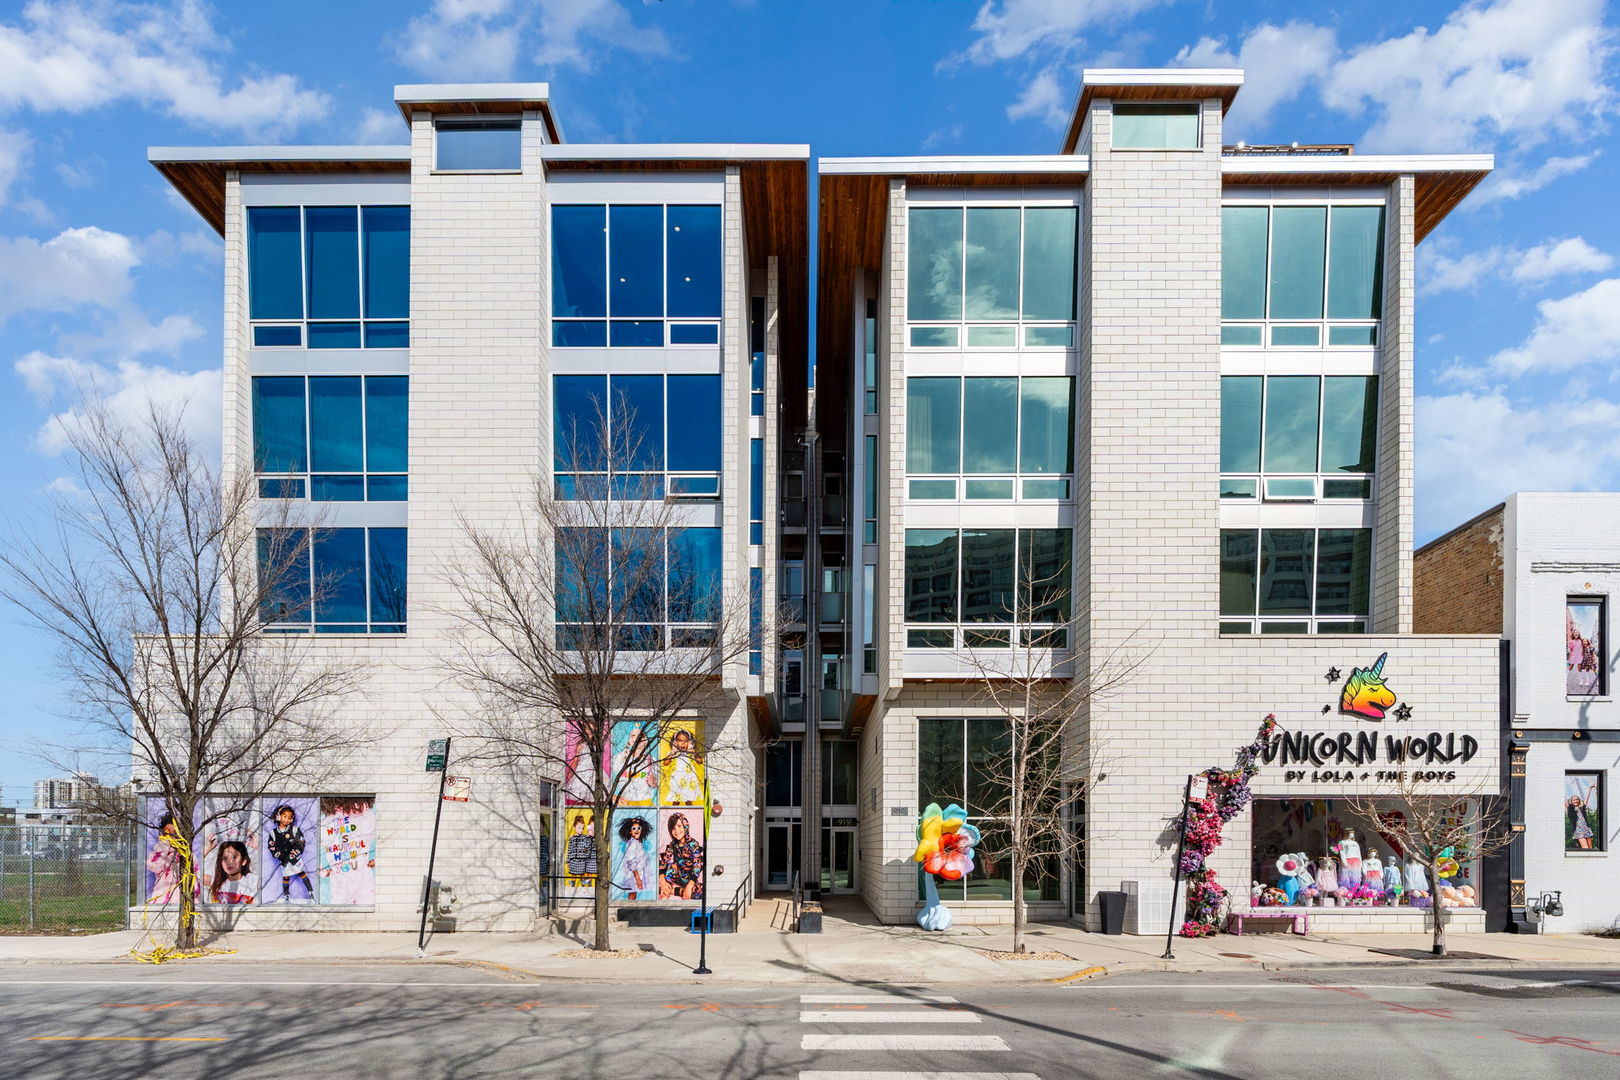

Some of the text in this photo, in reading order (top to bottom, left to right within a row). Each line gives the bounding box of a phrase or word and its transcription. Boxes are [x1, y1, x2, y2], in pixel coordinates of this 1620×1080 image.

[1261, 730, 1479, 767] UNICORN WORLD
[1286, 770, 1306, 781] BY
[1313, 770, 1354, 781] LOLA
[1414, 770, 1456, 781] BOYS
[837, 818, 852, 826] 919
[327, 824, 357, 836] WORLD
